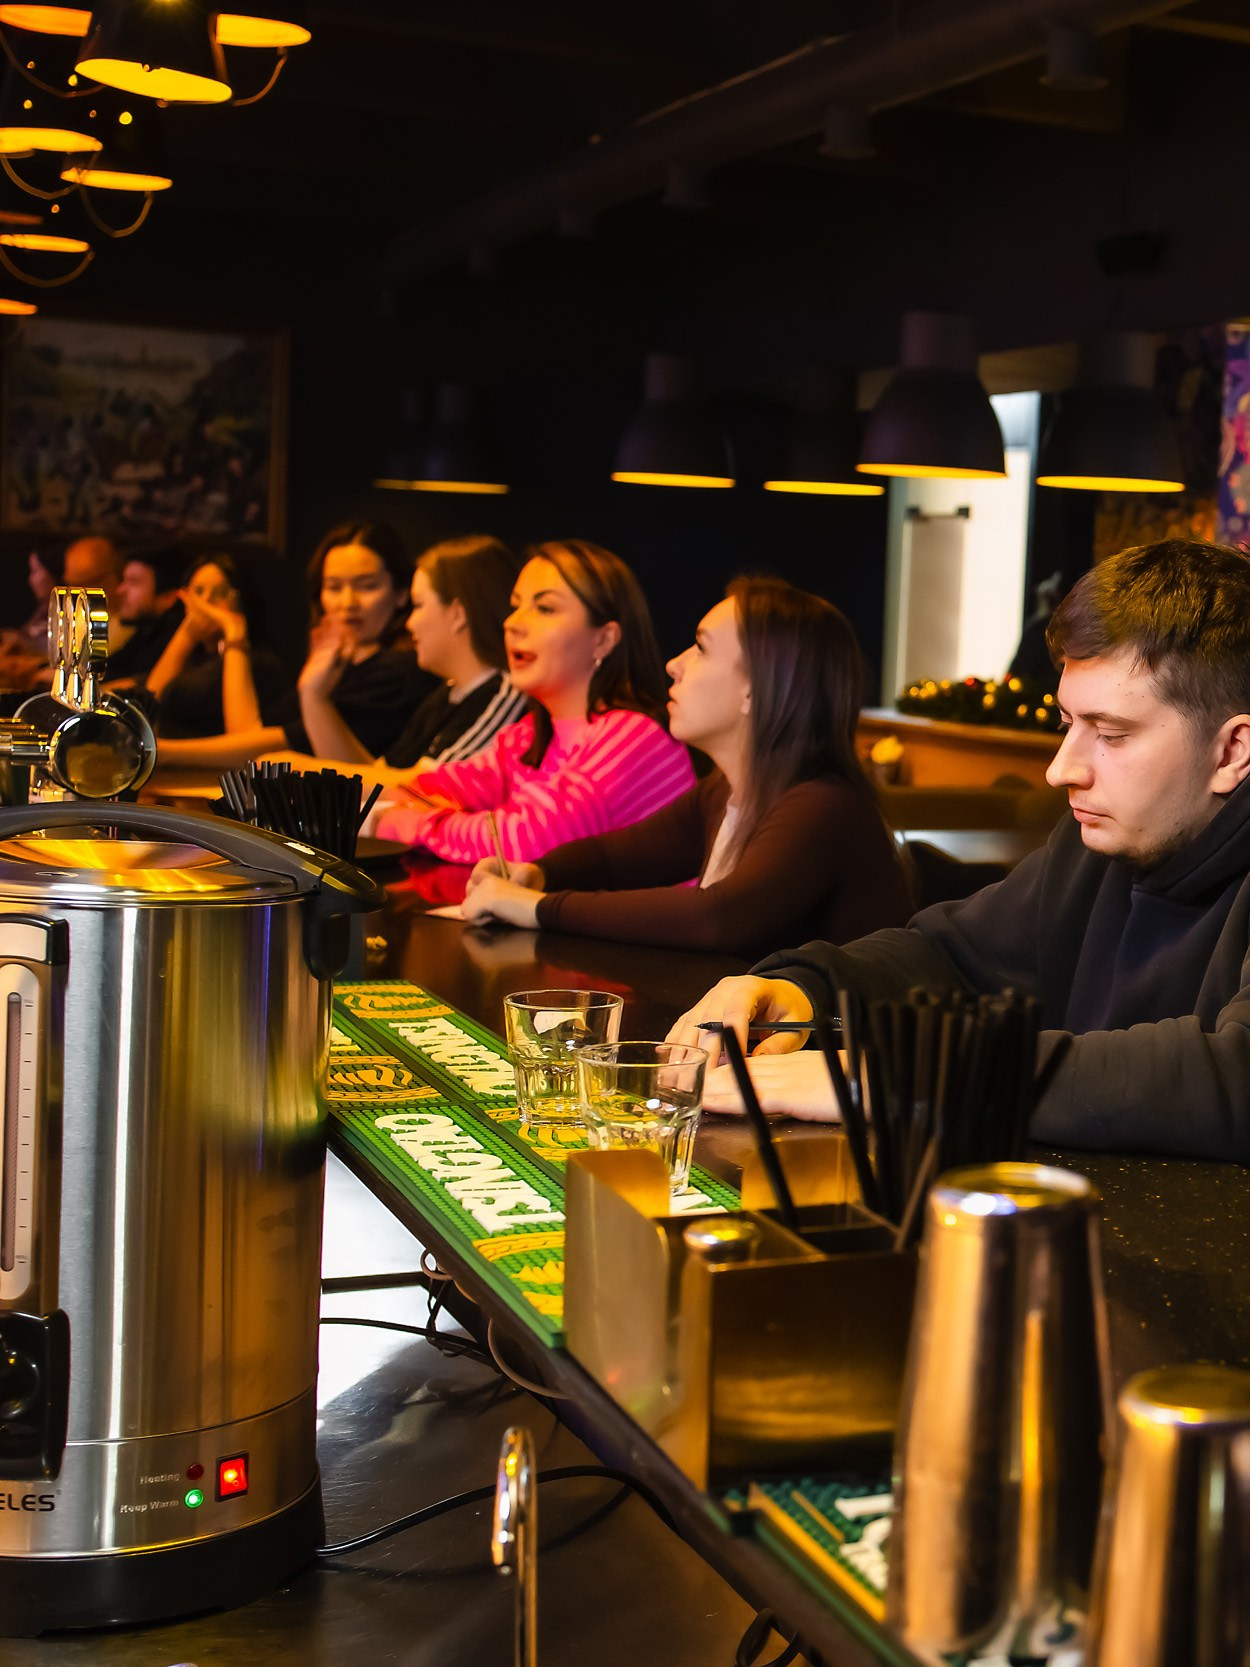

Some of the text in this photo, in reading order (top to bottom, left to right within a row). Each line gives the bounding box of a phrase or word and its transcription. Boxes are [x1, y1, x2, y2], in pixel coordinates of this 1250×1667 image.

[388, 1017, 525, 1099] TSINGTAO
[374, 1112, 567, 1235] TSINGTAO
[139, 1472, 181, 1486] Heating
[119, 1499, 179, 1514] Keep Warm
